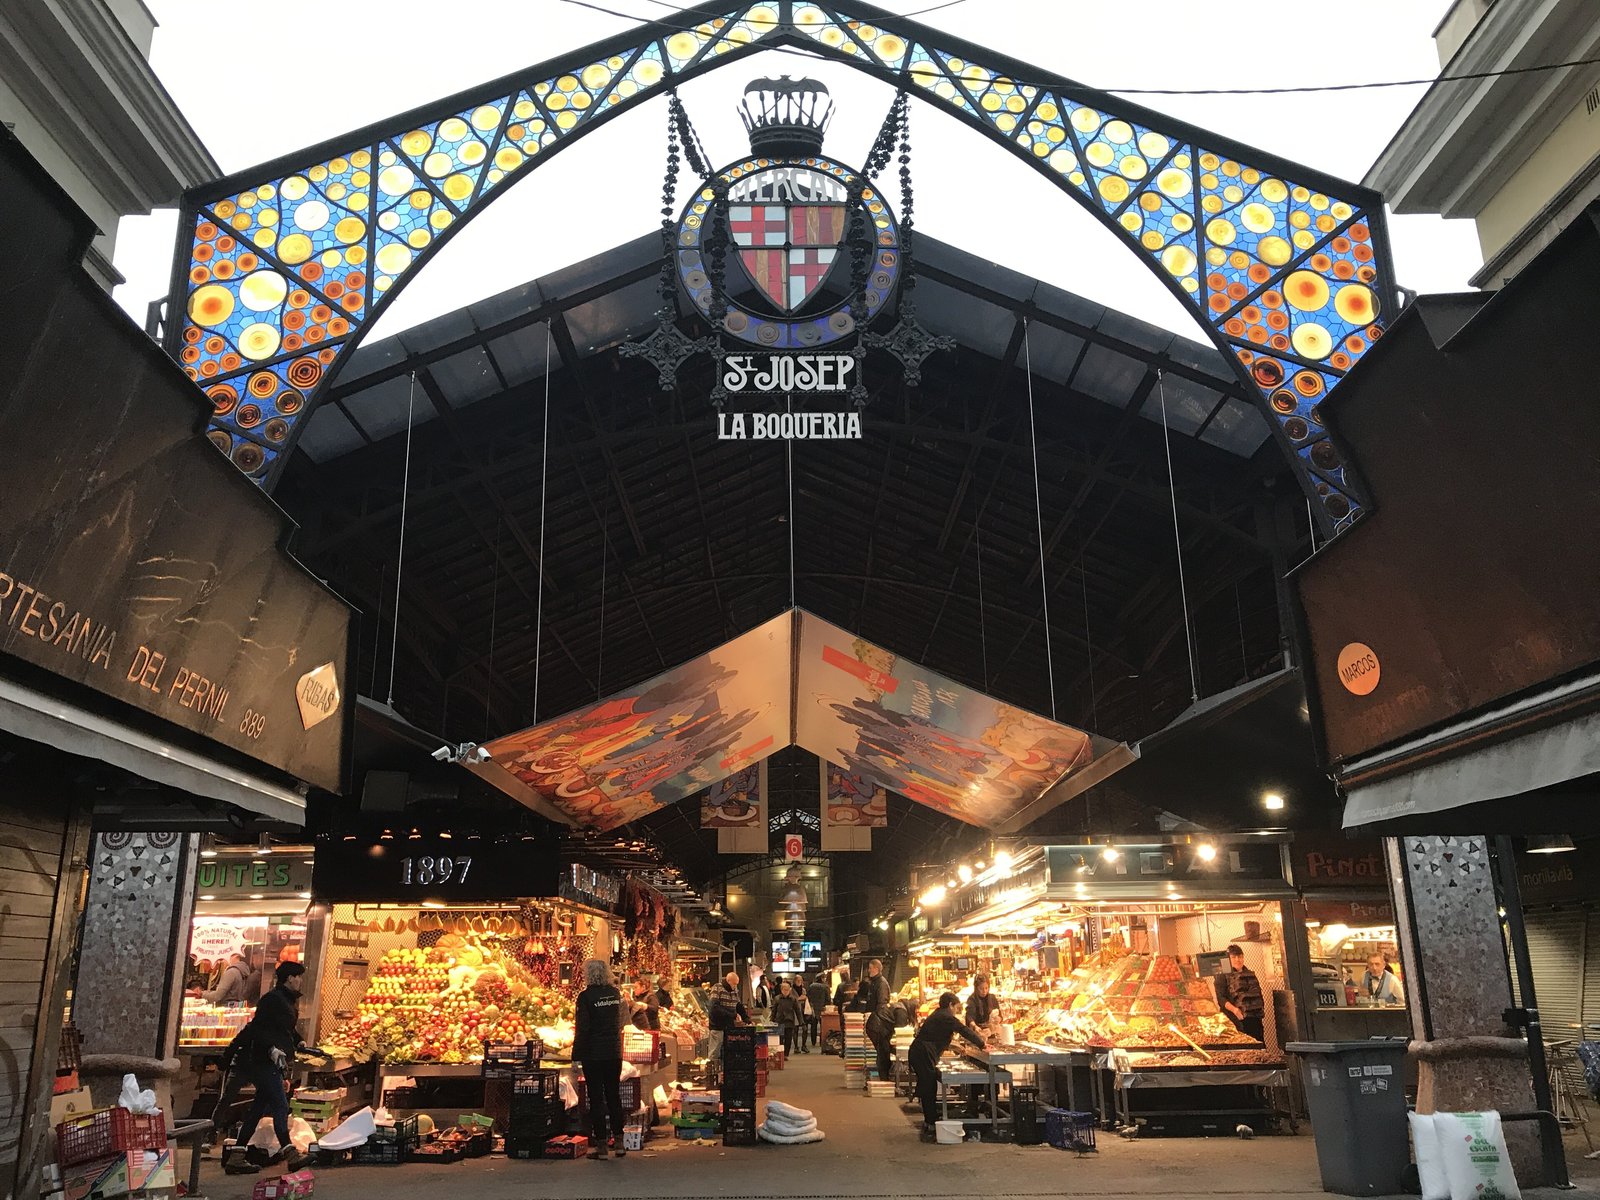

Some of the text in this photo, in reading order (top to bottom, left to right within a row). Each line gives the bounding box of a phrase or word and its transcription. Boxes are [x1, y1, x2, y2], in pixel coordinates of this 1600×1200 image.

[732, 168, 842, 203] MERCAT
[754, 355, 855, 391] JOSEP
[718, 412, 861, 439] LA BOQUERIA
[1341, 654, 1376, 684] MARCOS
[126, 645, 166, 694] DEL
[168, 666, 230, 724] PERNIL
[239, 709, 266, 739] 889
[302, 677, 336, 714] RIBAS
[789, 840, 799, 855] 6
[400, 856, 472, 885] 1897
[211, 928, 238, 939] NATURAL
[217, 946, 234, 955] JUICE
